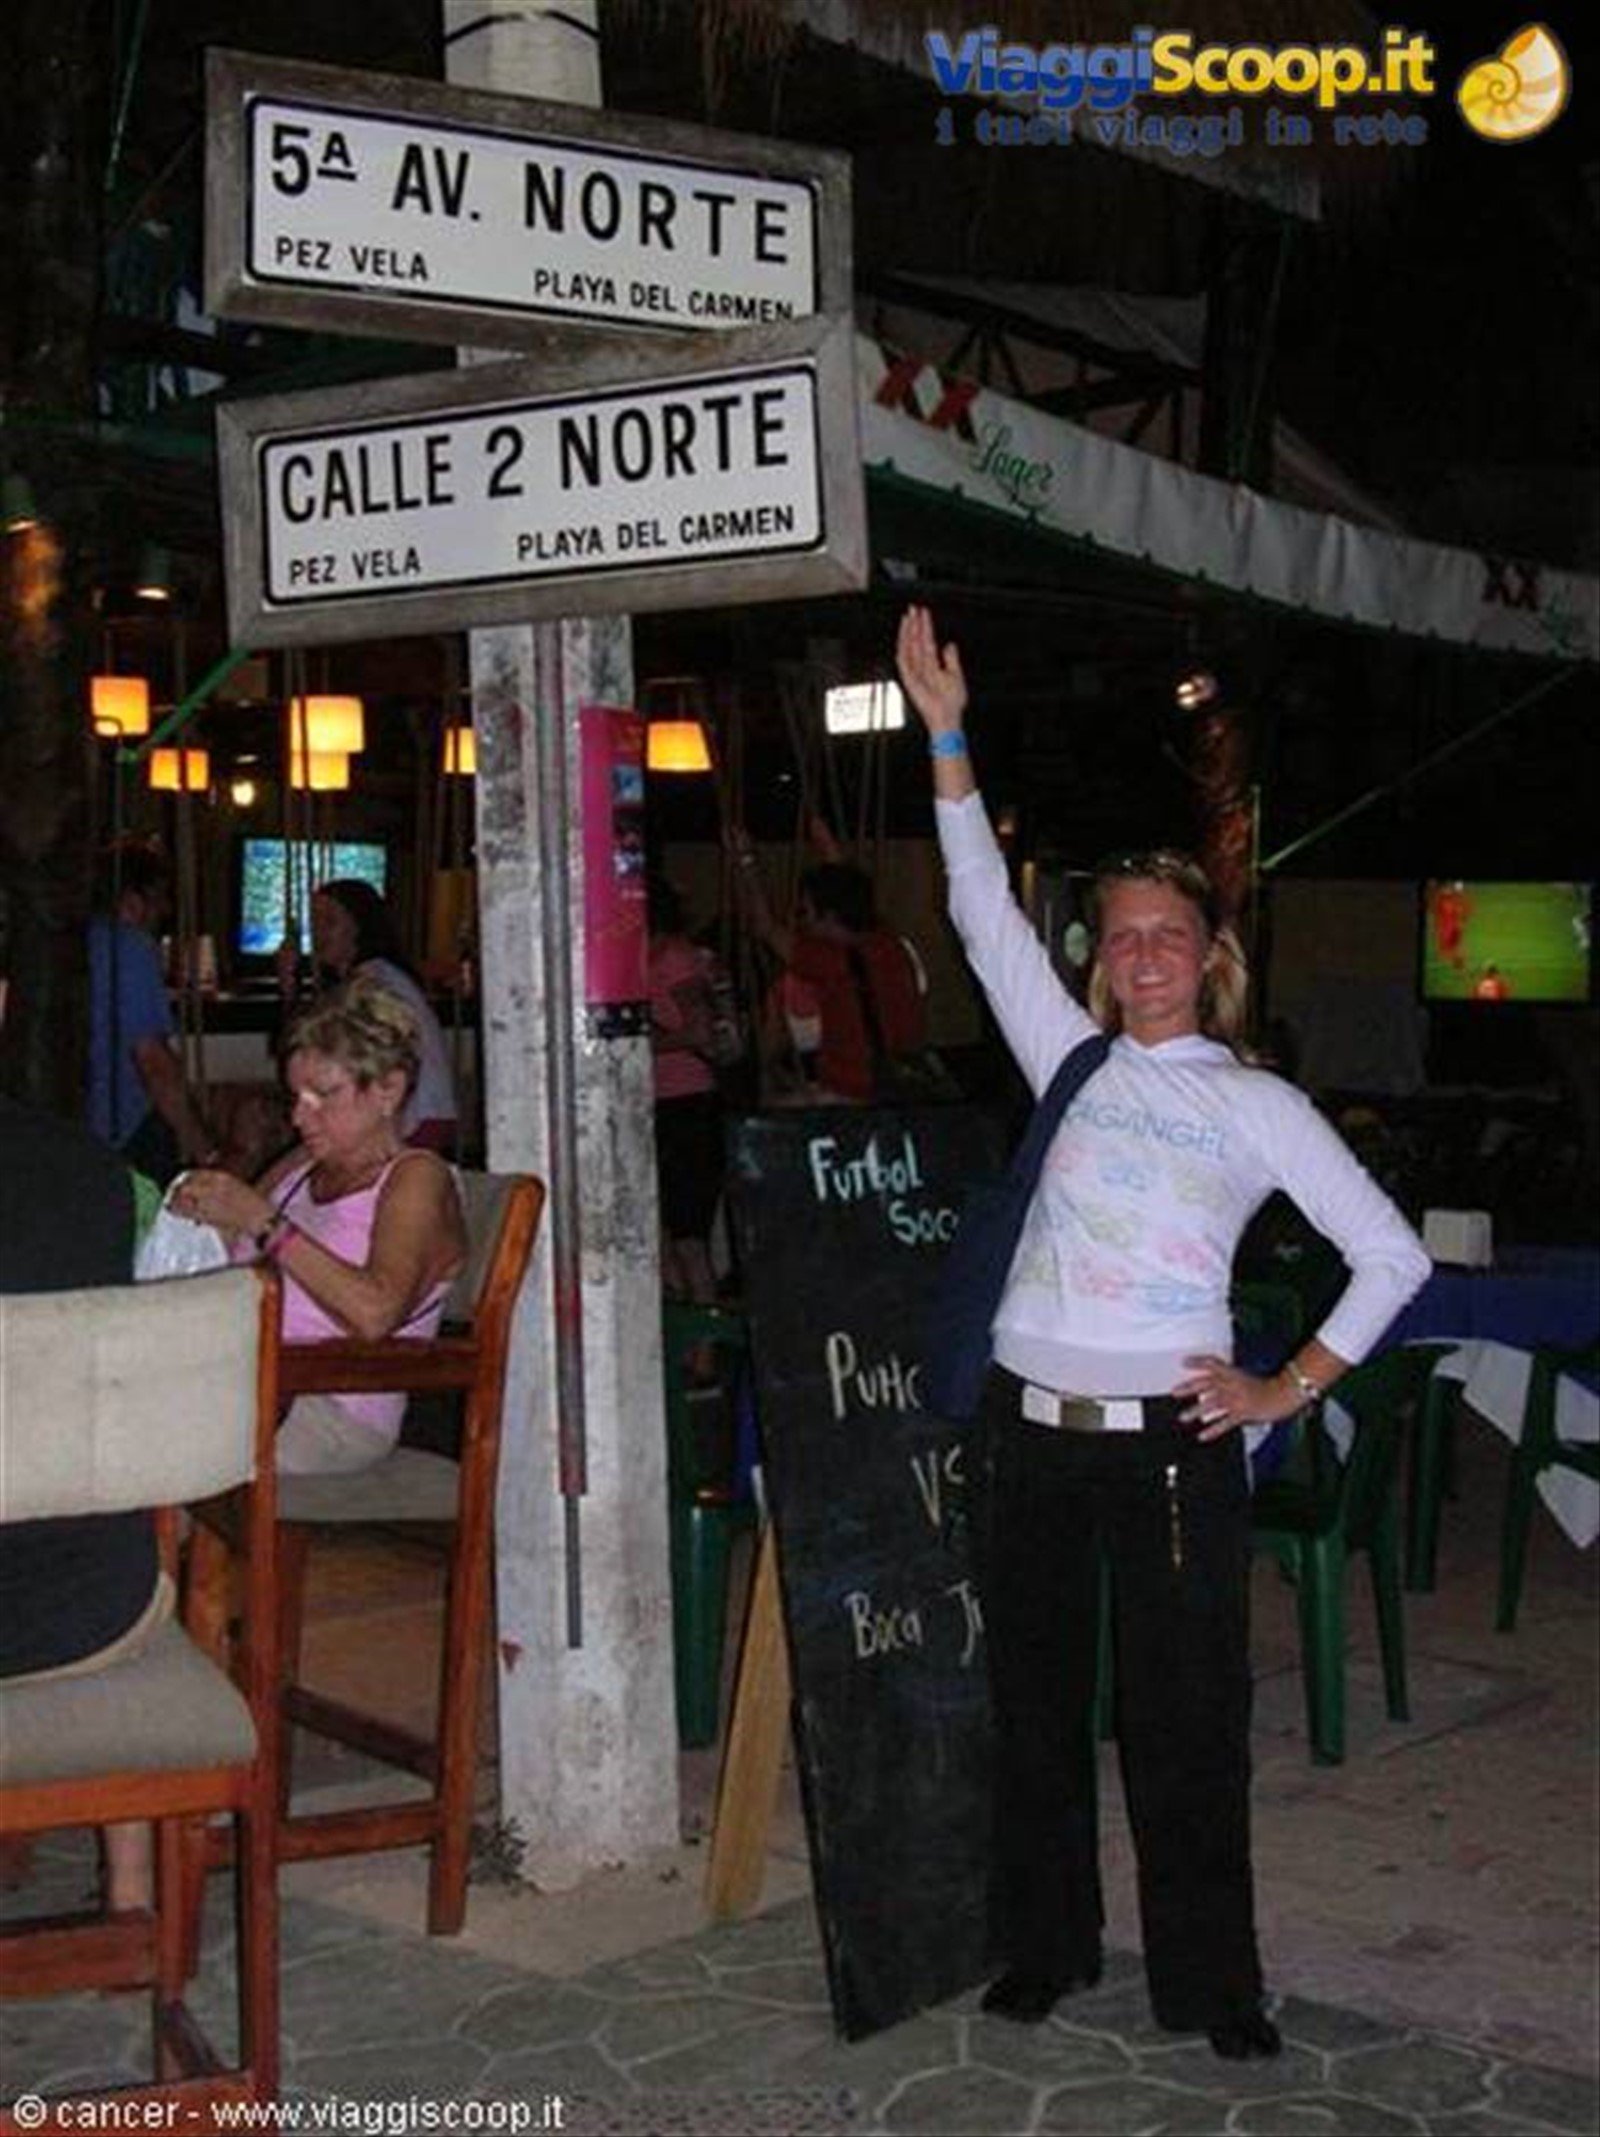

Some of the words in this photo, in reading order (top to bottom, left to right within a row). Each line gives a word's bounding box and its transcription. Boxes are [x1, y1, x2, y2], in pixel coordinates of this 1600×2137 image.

[391, 142, 481, 222] AV.
[524, 160, 789, 264] NORTE
[275, 235, 330, 272] PEZ
[349, 244, 429, 282] VELA
[534, 268, 617, 306] PLAYA
[629, 280, 678, 315] DEL
[688, 290, 793, 322] CARMEN
[280, 434, 455, 524] CALLE
[485, 425, 525, 499] 2
[558, 388, 790, 491] NORTE
[516, 526, 604, 561] PLAYA
[617, 519, 667, 551] DEL
[680, 504, 795, 545] CARMEN
[289, 556, 336, 586] PEZ
[354, 546, 421, 579] VELA
